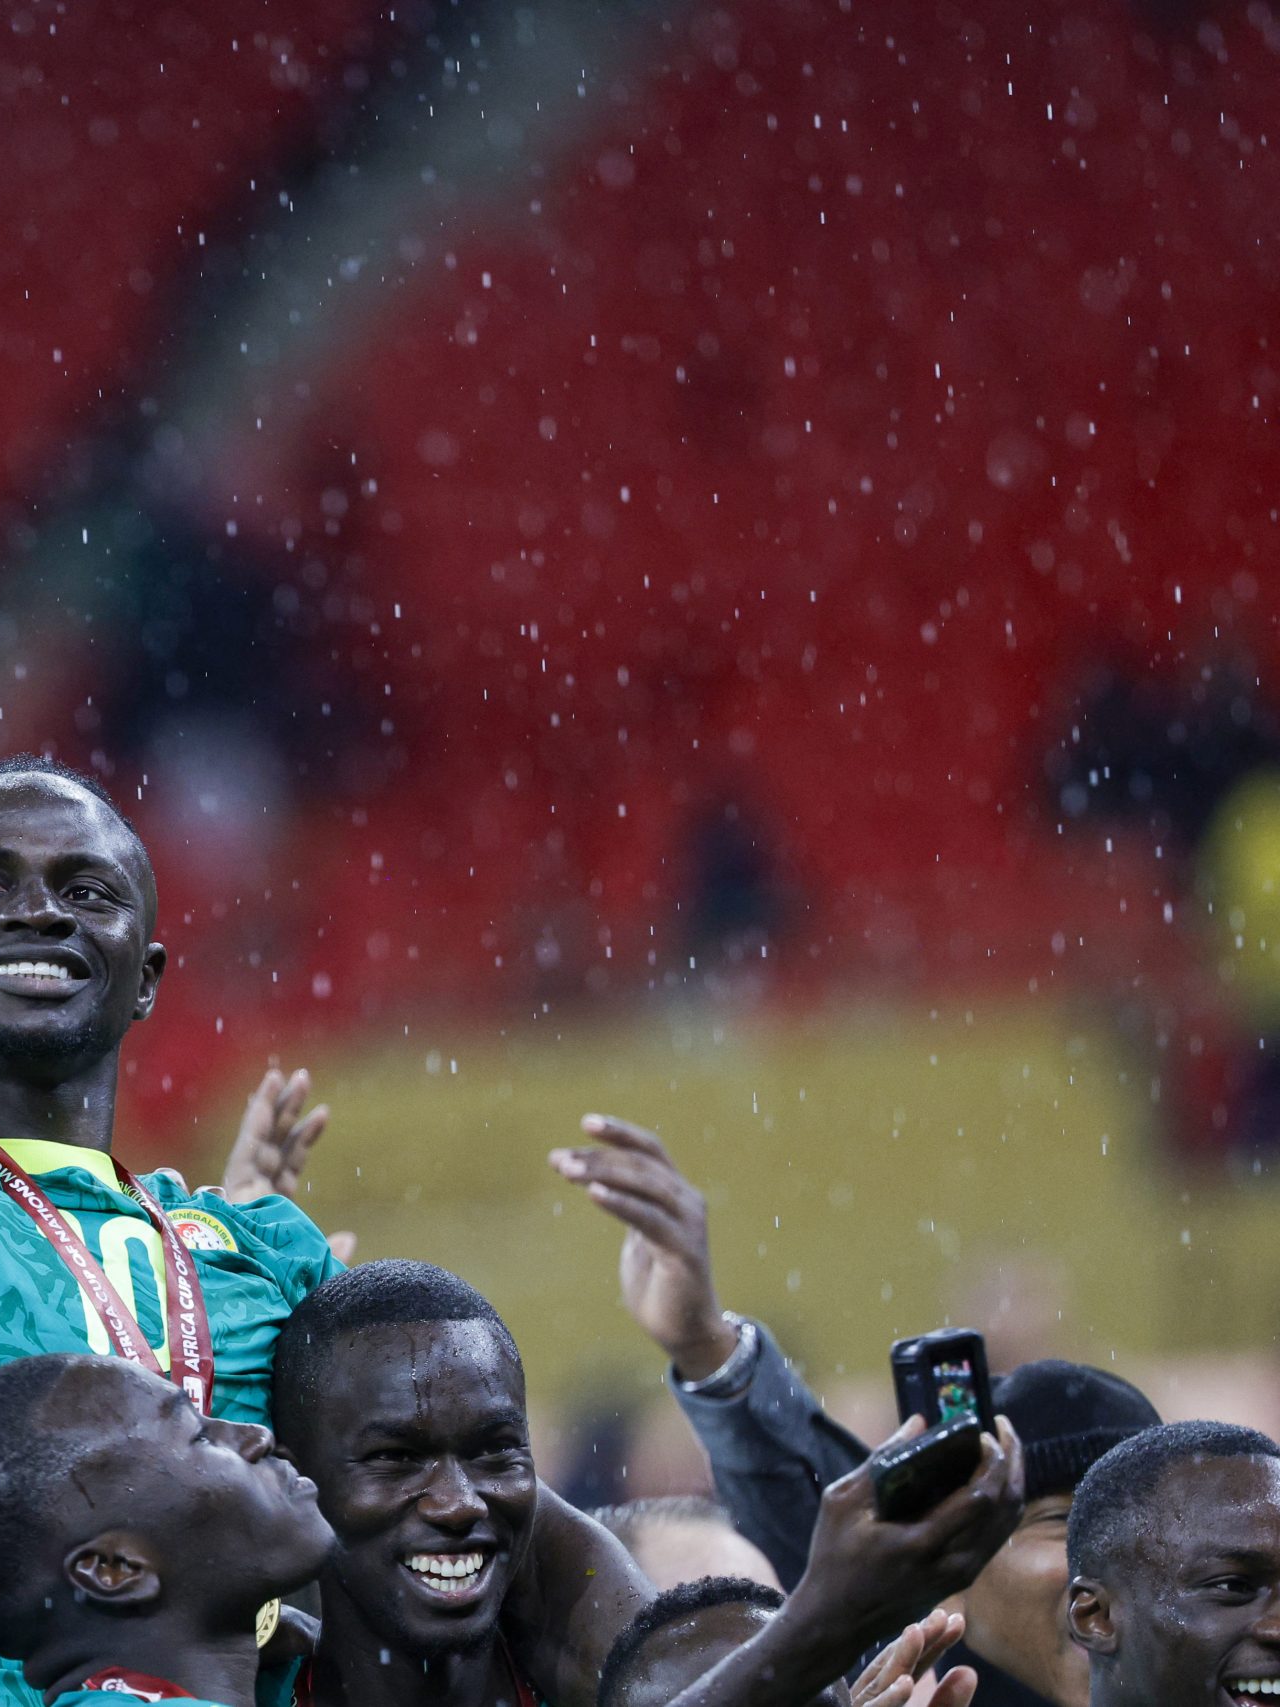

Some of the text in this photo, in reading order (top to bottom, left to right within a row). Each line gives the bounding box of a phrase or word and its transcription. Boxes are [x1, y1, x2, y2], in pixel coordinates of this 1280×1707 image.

[9, 1178, 71, 1243] NATIONS
[65, 1244, 87, 1268] OF
[173, 1251, 189, 1276] OF
[83, 1269, 109, 1303] CUP
[177, 1276, 195, 1310] CUP
[180, 1312, 200, 1373] AFRICA
